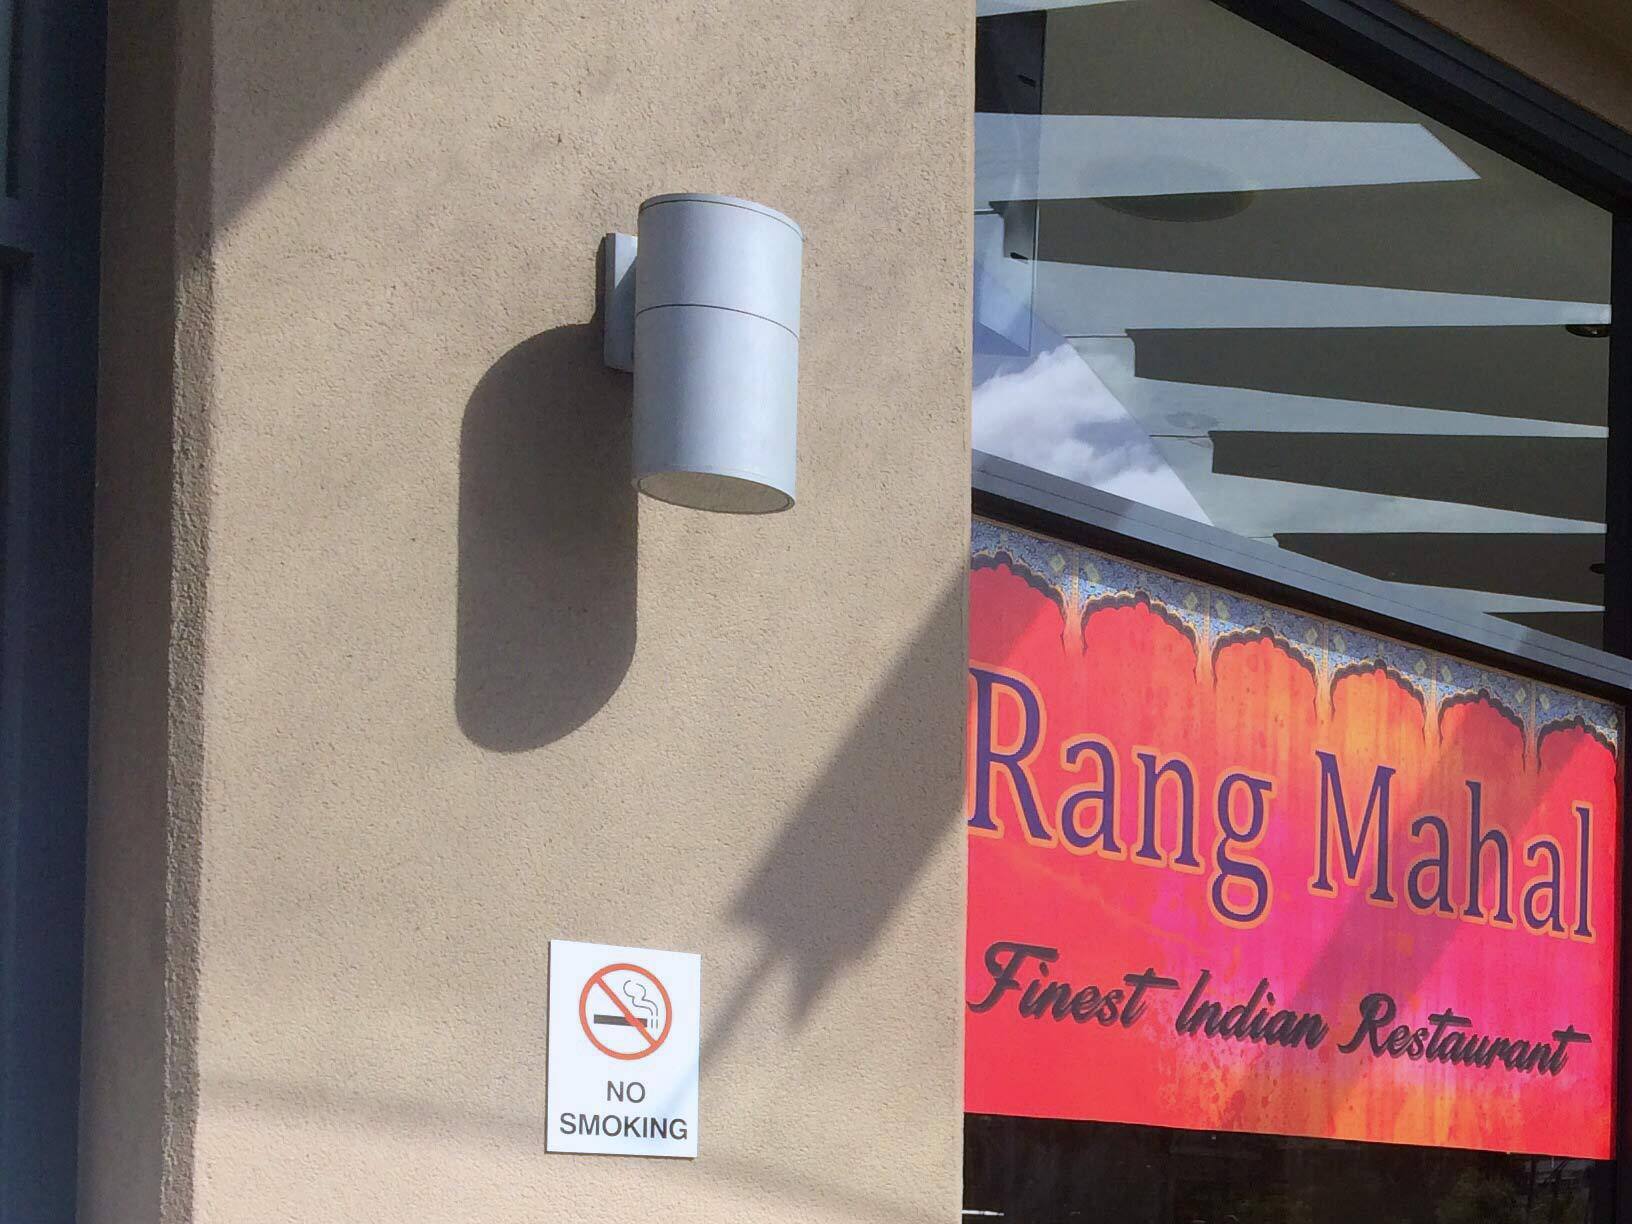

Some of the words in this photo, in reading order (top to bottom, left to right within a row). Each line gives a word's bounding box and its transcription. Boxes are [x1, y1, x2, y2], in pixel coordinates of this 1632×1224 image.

[967, 660, 1274, 927] Rang
[1307, 749, 1597, 943] Mahal
[967, 941, 1180, 1028] Finest
[1176, 969, 1329, 1050] Indian
[1337, 992, 1591, 1075] Restaurant
[559, 1112, 688, 1140] SMOKING
[607, 1080, 646, 1104] NO
